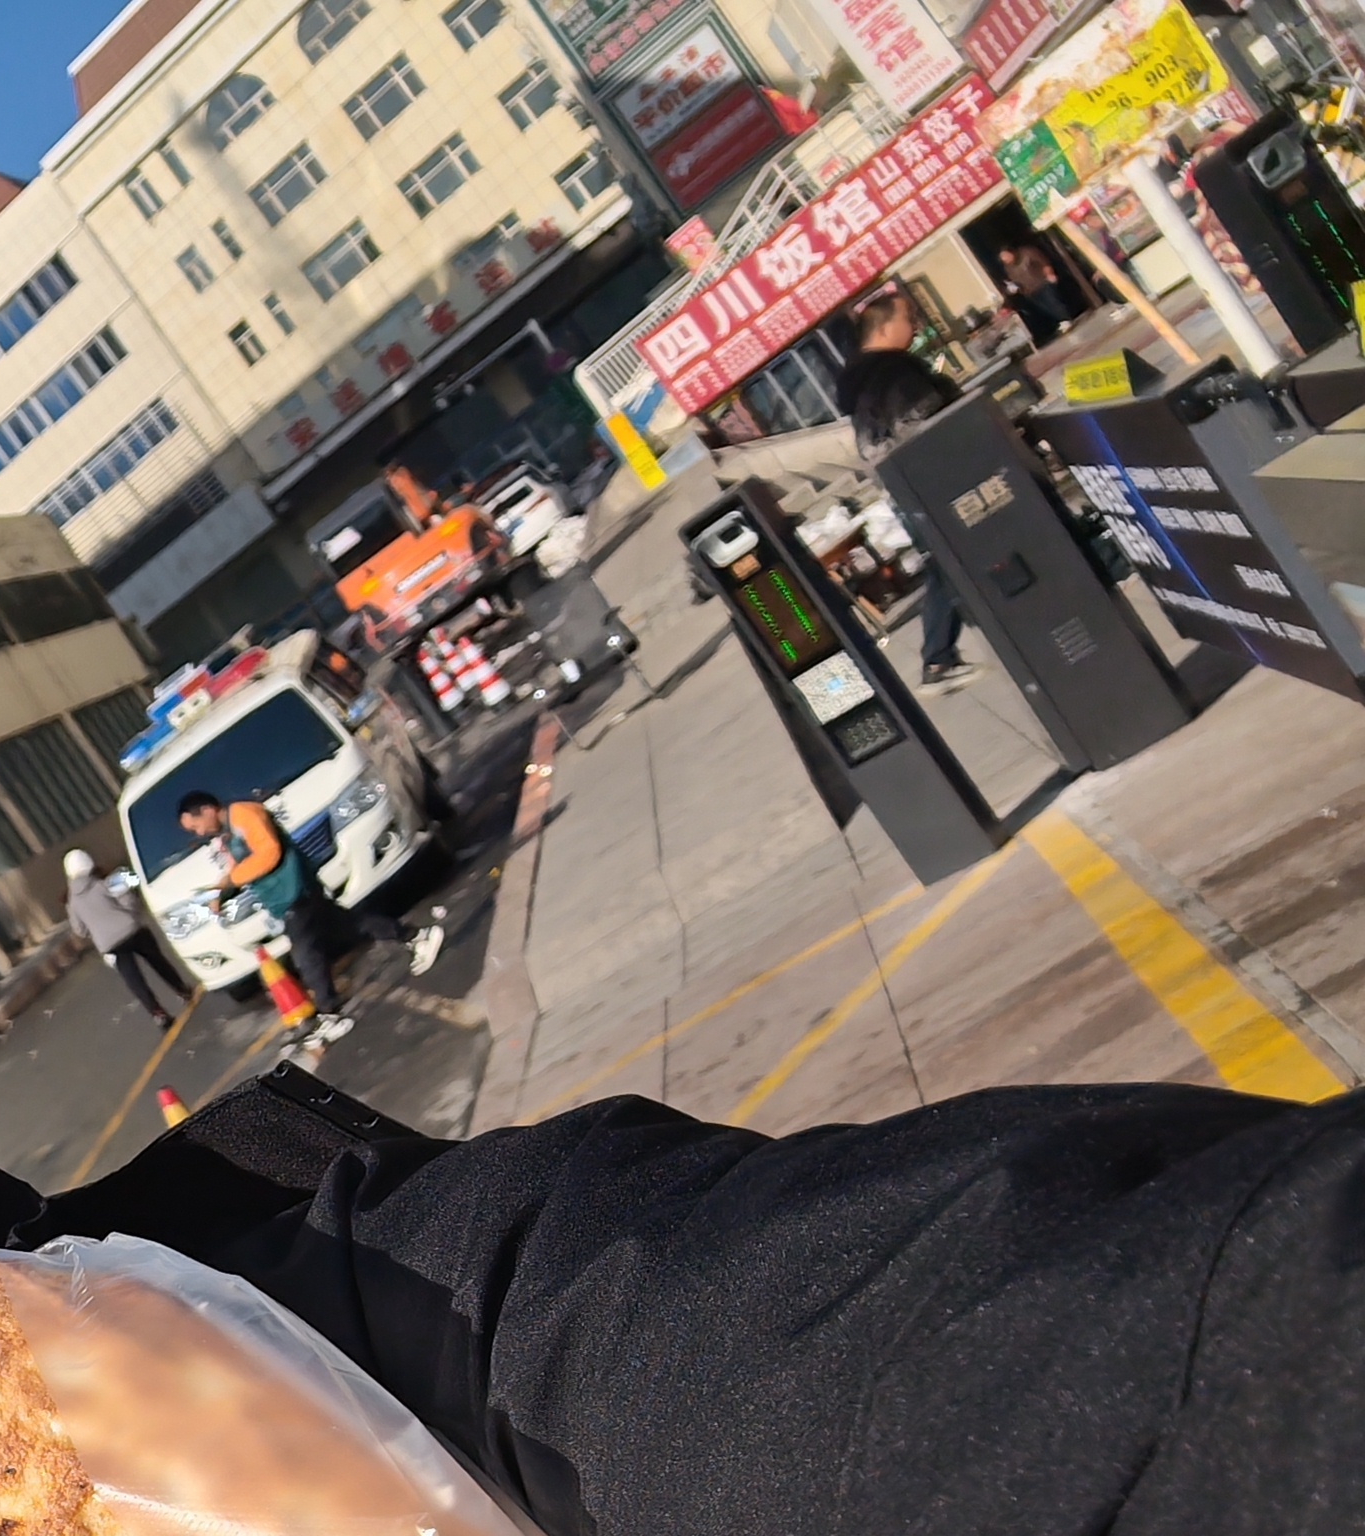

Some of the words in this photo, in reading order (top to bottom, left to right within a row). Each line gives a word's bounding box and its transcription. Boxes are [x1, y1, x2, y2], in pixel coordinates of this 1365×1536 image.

[869, 84, 984, 185] 山东饺子
[645, 175, 882, 371] 四川饭馆
